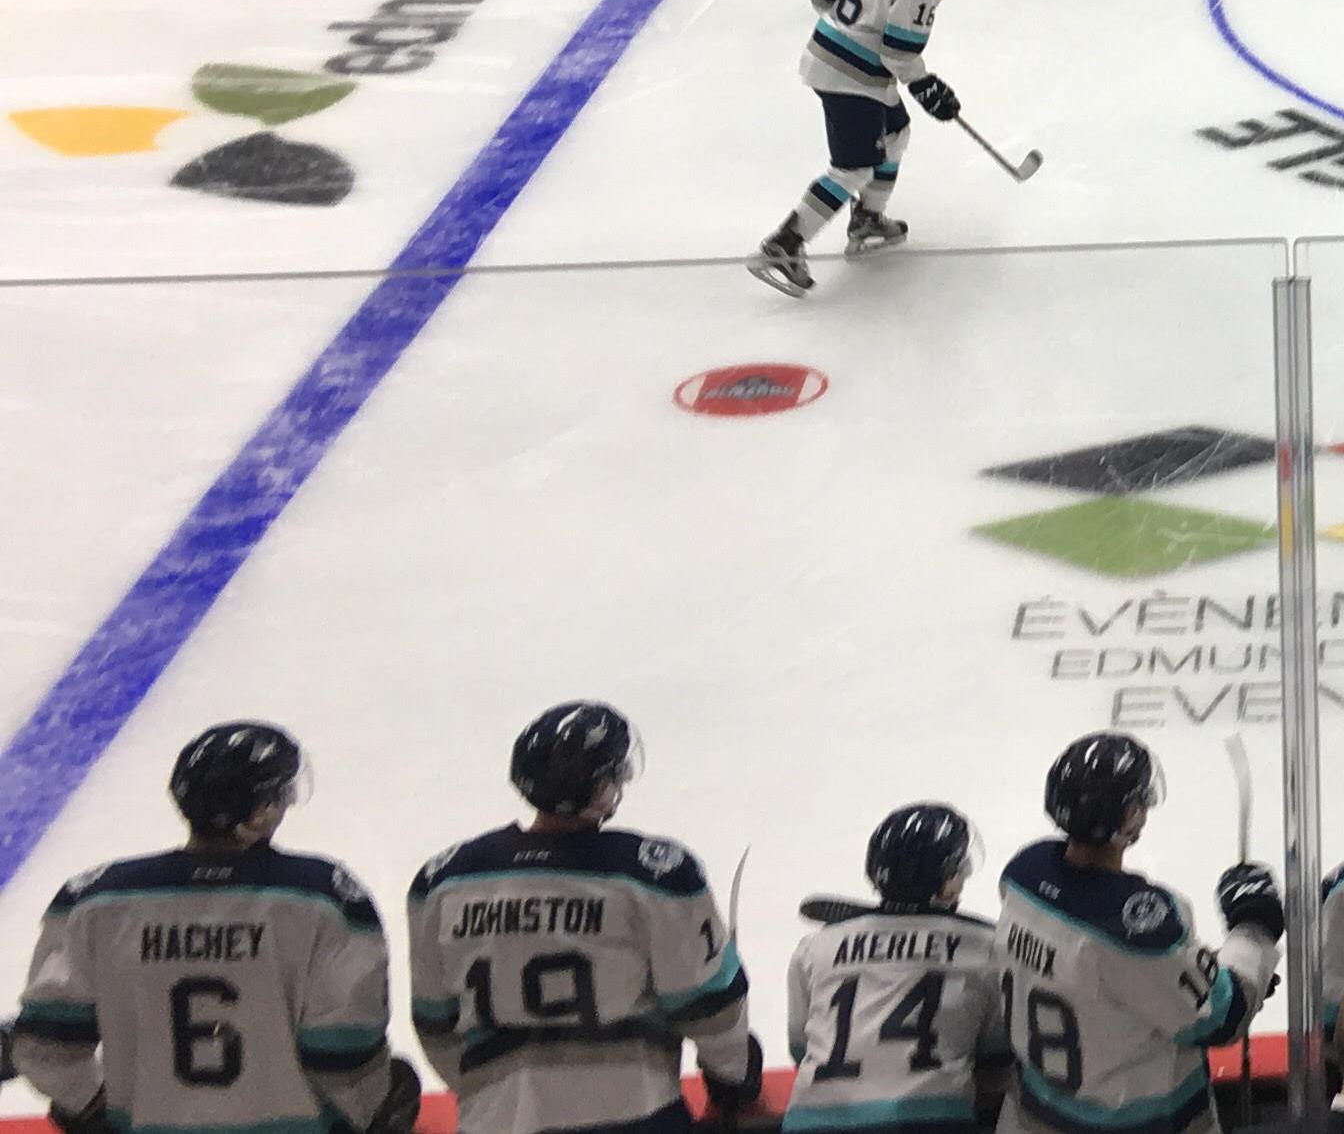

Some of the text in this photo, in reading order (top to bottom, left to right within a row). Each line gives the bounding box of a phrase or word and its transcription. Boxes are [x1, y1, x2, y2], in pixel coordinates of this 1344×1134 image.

[140, 922, 266, 965] HACHEY
[452, 896, 606, 941] JOHNSTON
[831, 931, 962, 968] AKERLEY
[464, 949, 598, 1040] 19
[812, 970, 948, 1082] 14
[169, 975, 241, 1089] 6
